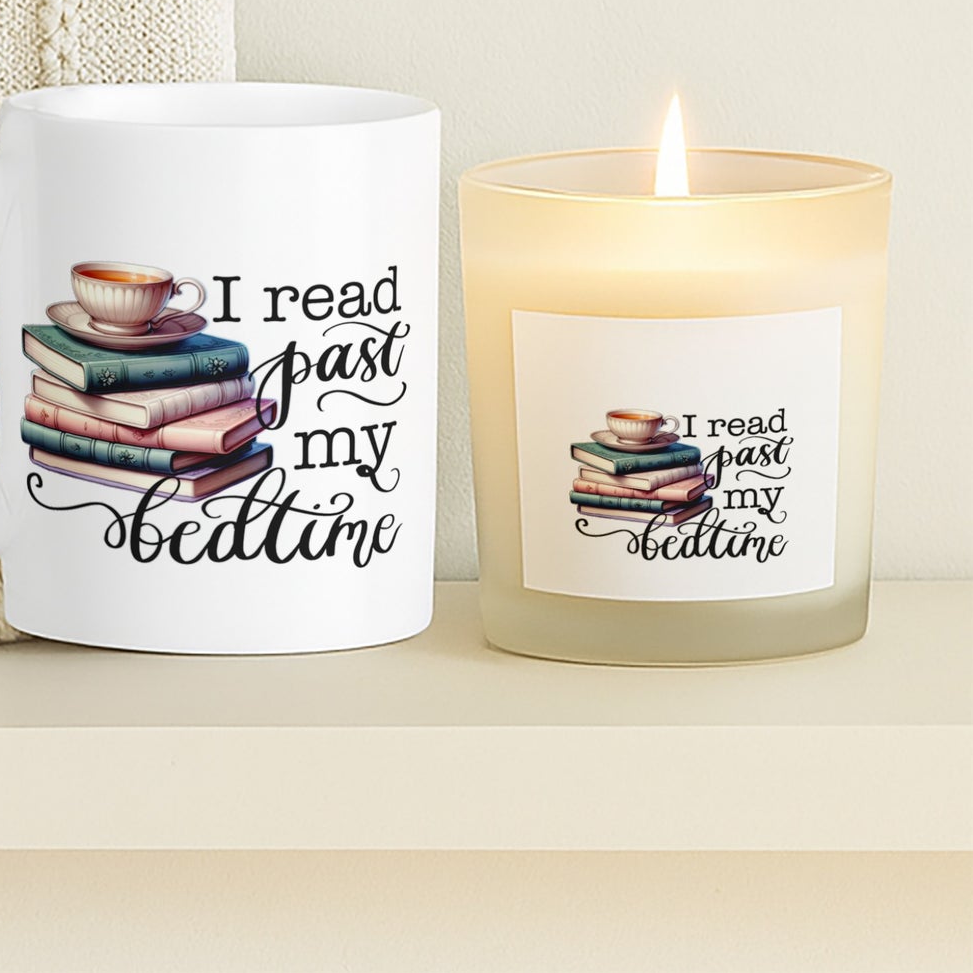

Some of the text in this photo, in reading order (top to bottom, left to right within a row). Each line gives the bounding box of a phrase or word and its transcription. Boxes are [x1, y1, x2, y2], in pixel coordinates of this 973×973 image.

[212, 265, 402, 323] I read
[249, 321, 411, 430] past
[682, 408, 788, 438] I read
[294, 420, 401, 493] my
[702, 435, 794, 490] past
[27, 467, 403, 568] bedtime
[723, 486, 788, 524] my
[575, 507, 789, 563] bedtime
